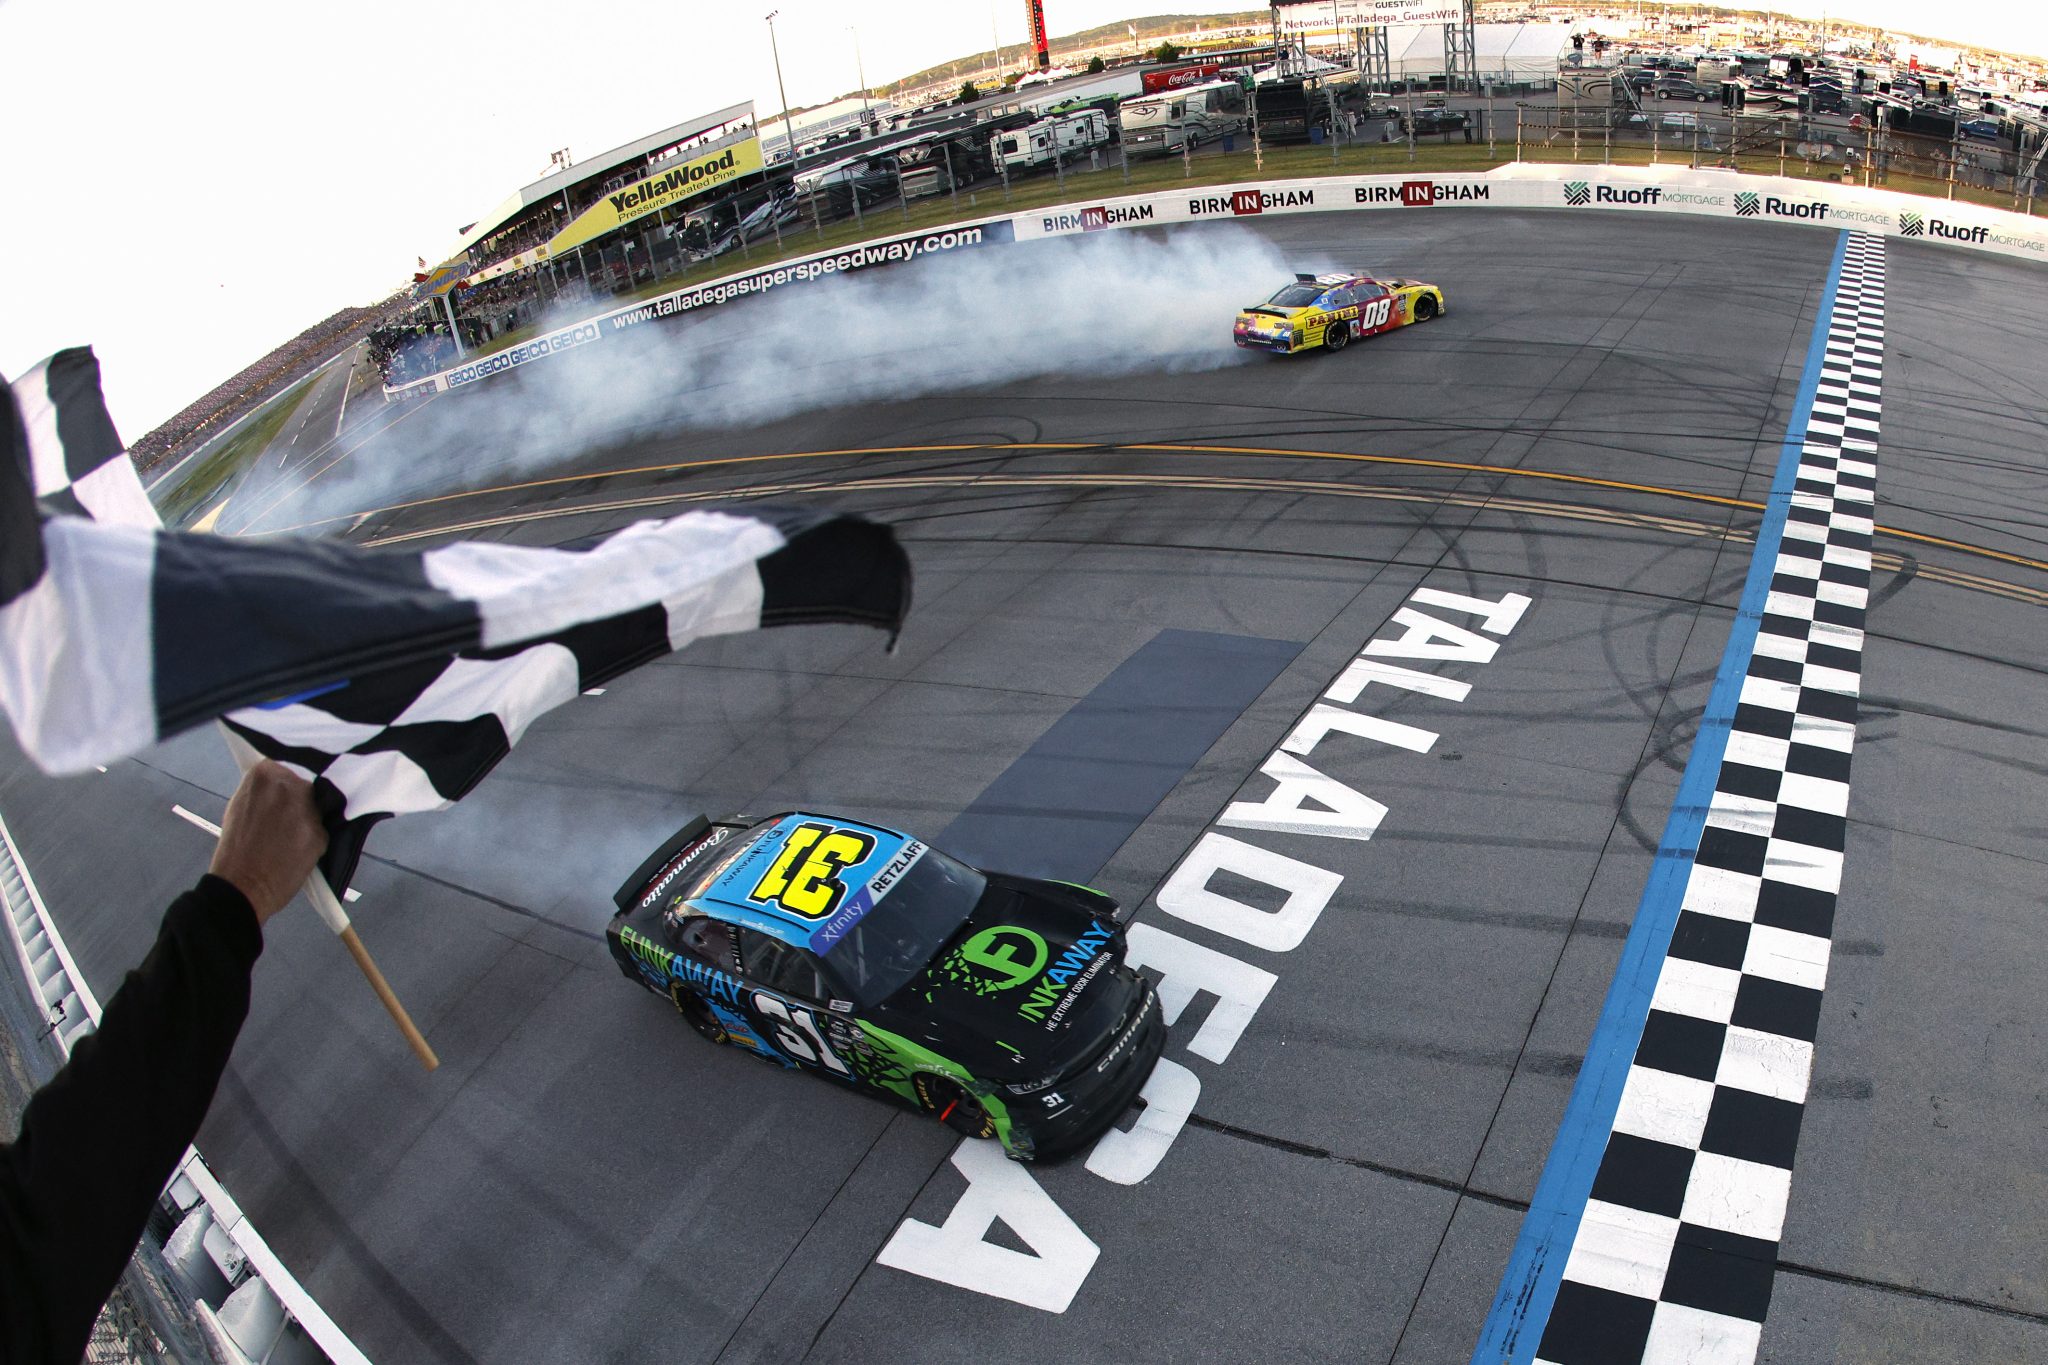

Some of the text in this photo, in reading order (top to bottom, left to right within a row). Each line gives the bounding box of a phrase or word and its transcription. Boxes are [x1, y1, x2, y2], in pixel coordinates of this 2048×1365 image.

[1285, 9, 1460, 30] Network: #Talladega_GuestWifi
[609, 150, 735, 213] YellaWood
[618, 169, 736, 223] Pressure Treated Pine
[1355, 183, 1489, 204] BIRMINGHAM
[1596, 185, 1725, 206] Ruoff MORTGAGE
[1043, 205, 1154, 232] BIRMINGHAM
[1189, 190, 1314, 215] BIRMINGHAM
[1765, 198, 1890, 226] Ruoff MORTGAGE
[1929, 219, 2046, 252] Ruoff MORTGAGE
[613, 228, 983, 330] www.talladegasuperspeedway.com
[1308, 307, 1357, 328] PANINI
[1363, 298, 1391, 330] 08
[448, 324, 596, 386] GEICO GEICO GEICO GEICO
[642, 827, 729, 908] Bommarito
[747, 822, 879, 920] 31
[870, 840, 927, 895] RETZLAFF
[820, 901, 865, 943] xfinity
[619, 925, 744, 1006] FUNKAWAY
[1051, 993, 1074, 1023] EXTREME
[1072, 975, 1089, 995] ODOR
[1086, 951, 1114, 980] ELIMINATOR
[1042, 1092, 1065, 1108] 31
